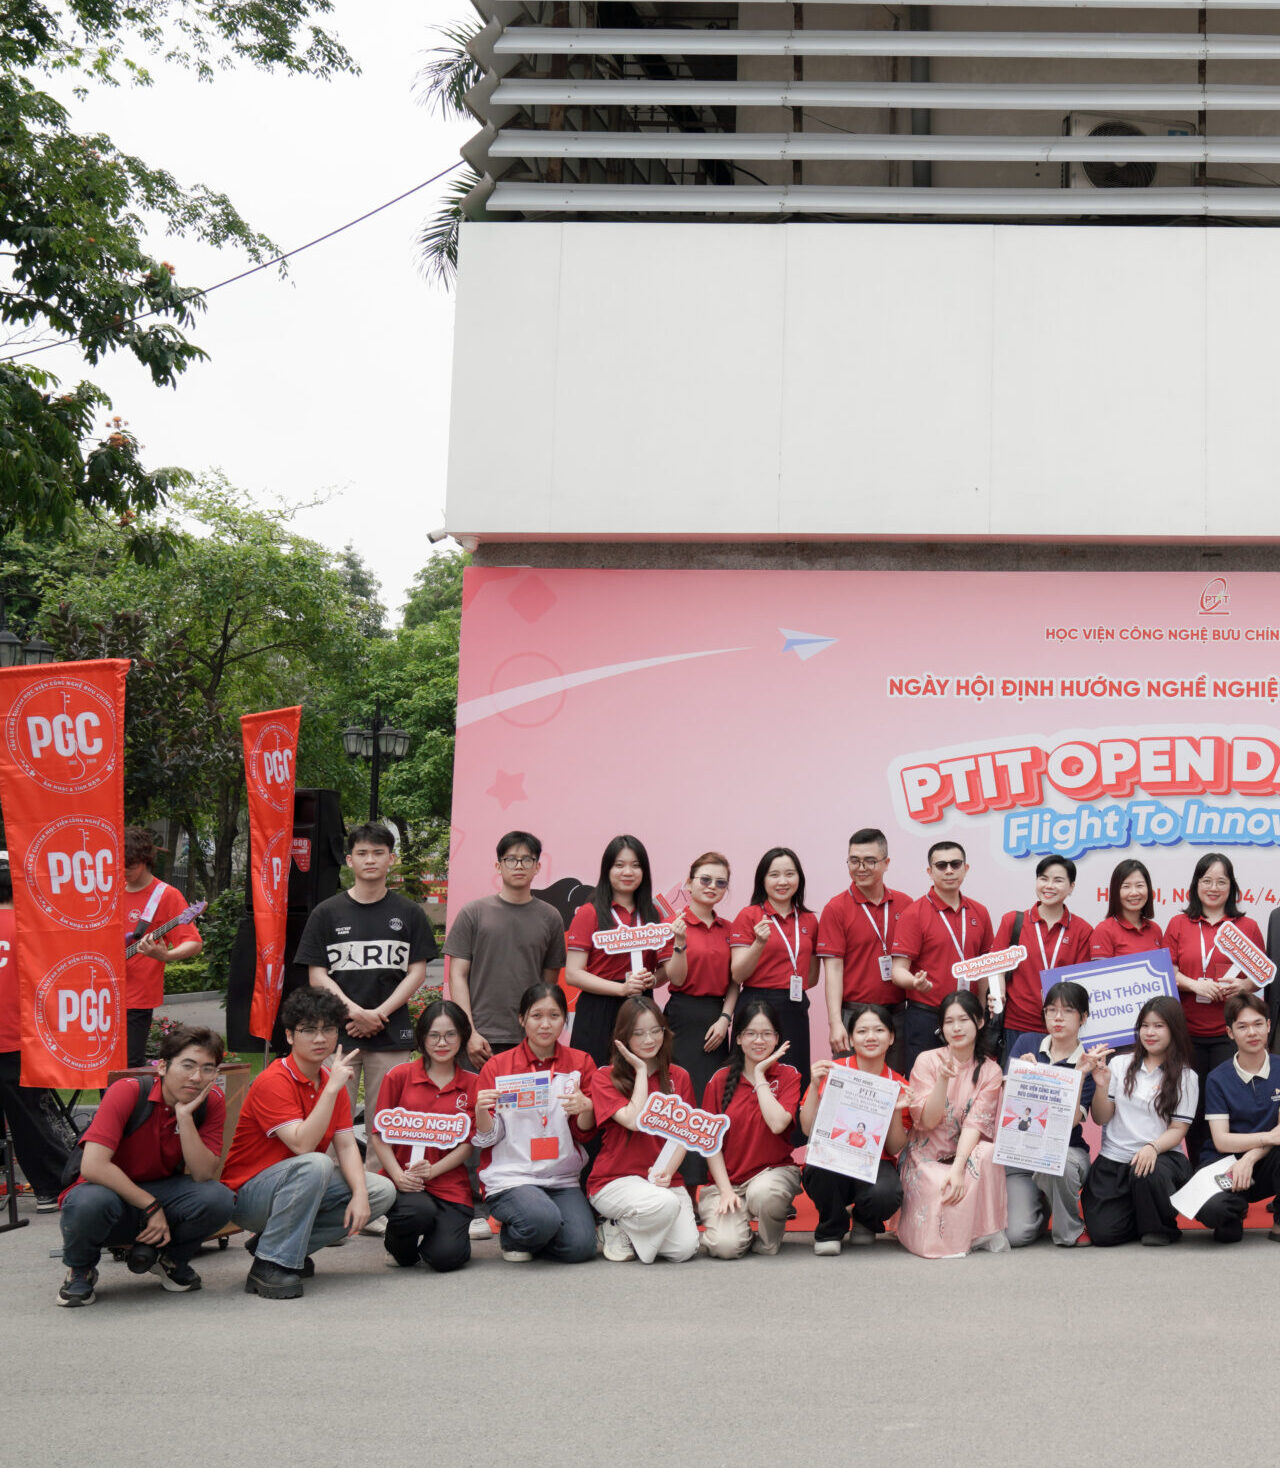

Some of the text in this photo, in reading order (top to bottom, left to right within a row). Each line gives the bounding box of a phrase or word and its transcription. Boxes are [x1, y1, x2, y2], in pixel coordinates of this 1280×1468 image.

[1045, 628, 1078, 643] HỌC
[1082, 626, 1115, 643] VIỆN
[1119, 626, 1164, 640] CÔNG
[1168, 627, 1208, 643] NGHỆ
[1212, 628, 1241, 641] BƯU
[889, 675, 949, 696] NGÀY
[956, 675, 994, 702] HỘI
[1001, 679, 1054, 702] ĐỊNH
[1061, 675, 1141, 697] HƯỚNG
[1147, 675, 1207, 697] NGHỀ
[27, 712, 103, 758] PGC
[901, 748, 1038, 816] PTIT
[1047, 738, 1218, 794] OPEN
[1008, 804, 1119, 850] Flight
[1132, 805, 1173, 837] To
[47, 849, 113, 894] PGC
[597, 927, 671, 943] TRUYỀN THÔNG
[1223, 926, 1273, 977] MULTIMEDIA
[58, 988, 111, 1032] PGC
[1114, 981, 1161, 999] THÔNG
[381, 1112, 464, 1135] CÔNG NGHỆ
[650, 1098, 722, 1137] BÁO CHÍ
